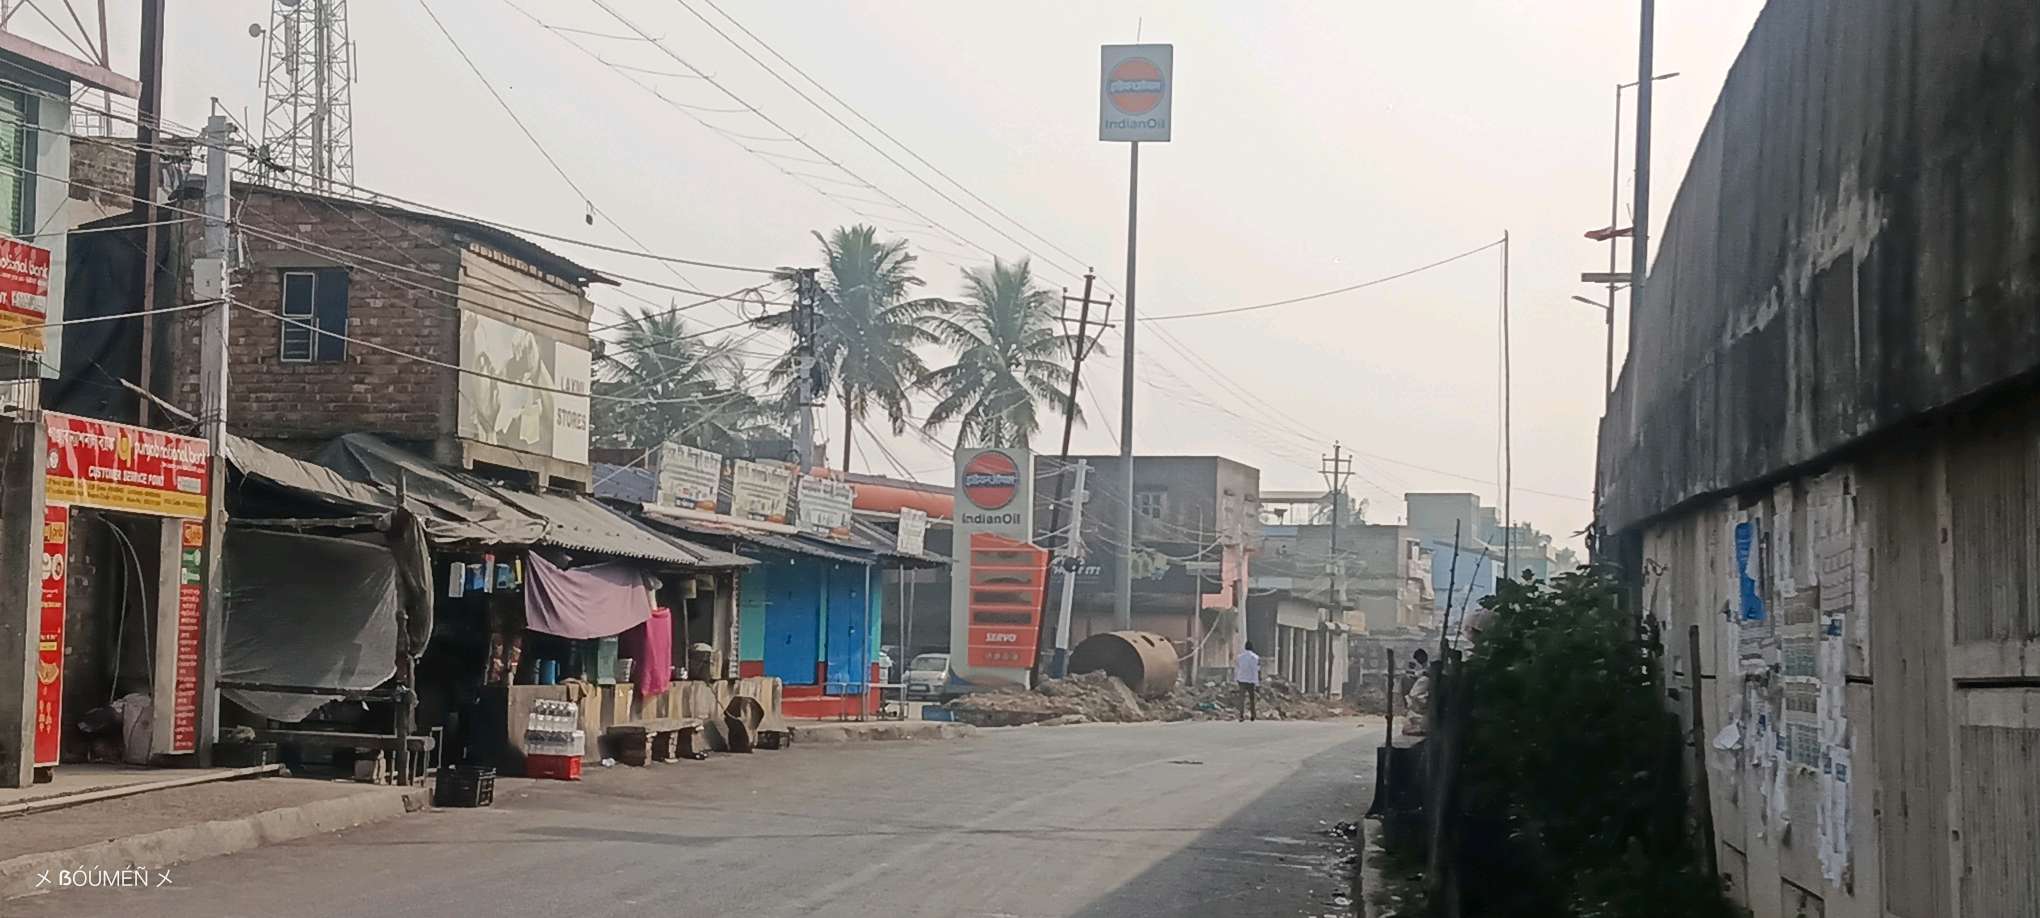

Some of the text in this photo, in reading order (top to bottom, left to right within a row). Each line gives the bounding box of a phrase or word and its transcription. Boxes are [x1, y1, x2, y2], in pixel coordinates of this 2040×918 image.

[1105, 118, 1166, 129] IndianOil
[557, 408, 586, 431] STORES
[88, 465, 122, 482] CUSTOMER
[123, 470, 148, 484] SERVICE
[961, 513, 1021, 525] IndianOil
[985, 632, 1017, 643] SERVO
